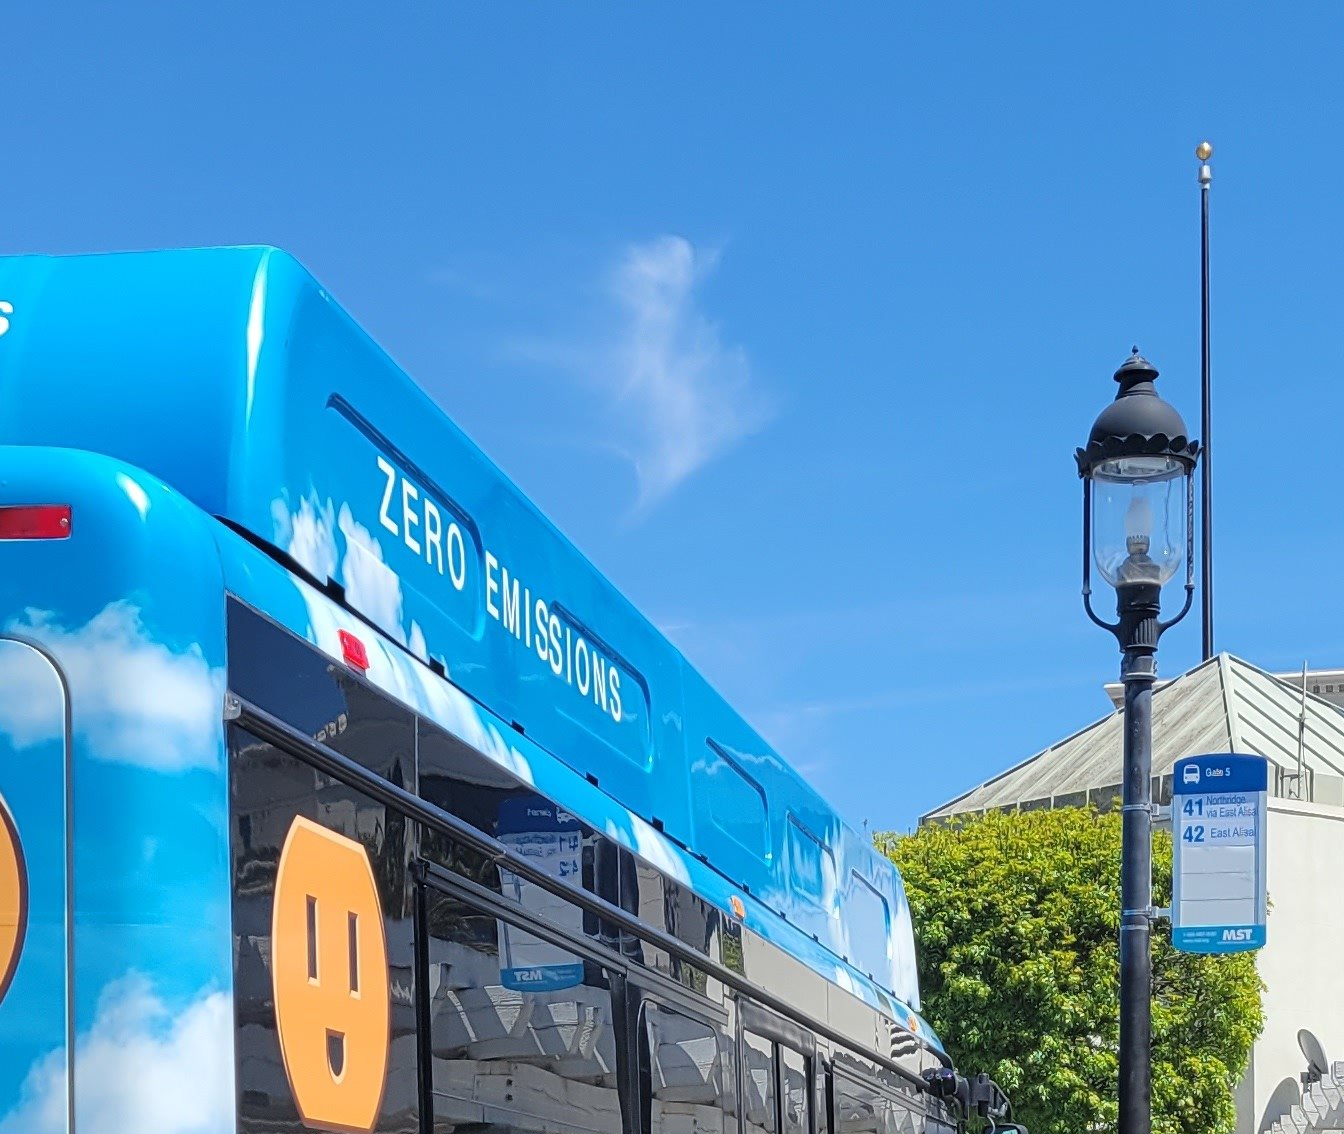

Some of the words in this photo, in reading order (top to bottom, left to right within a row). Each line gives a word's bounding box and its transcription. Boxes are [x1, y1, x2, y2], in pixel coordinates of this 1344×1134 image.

[377, 456, 465, 591] ZERO
[484, 550, 622, 723] EMISSIONS
[1182, 798, 1203, 816] 41
[1219, 807, 1236, 818] East
[1182, 825, 1205, 843] 42
[1210, 827, 1231, 838] East
[1222, 928, 1253, 941] MST
